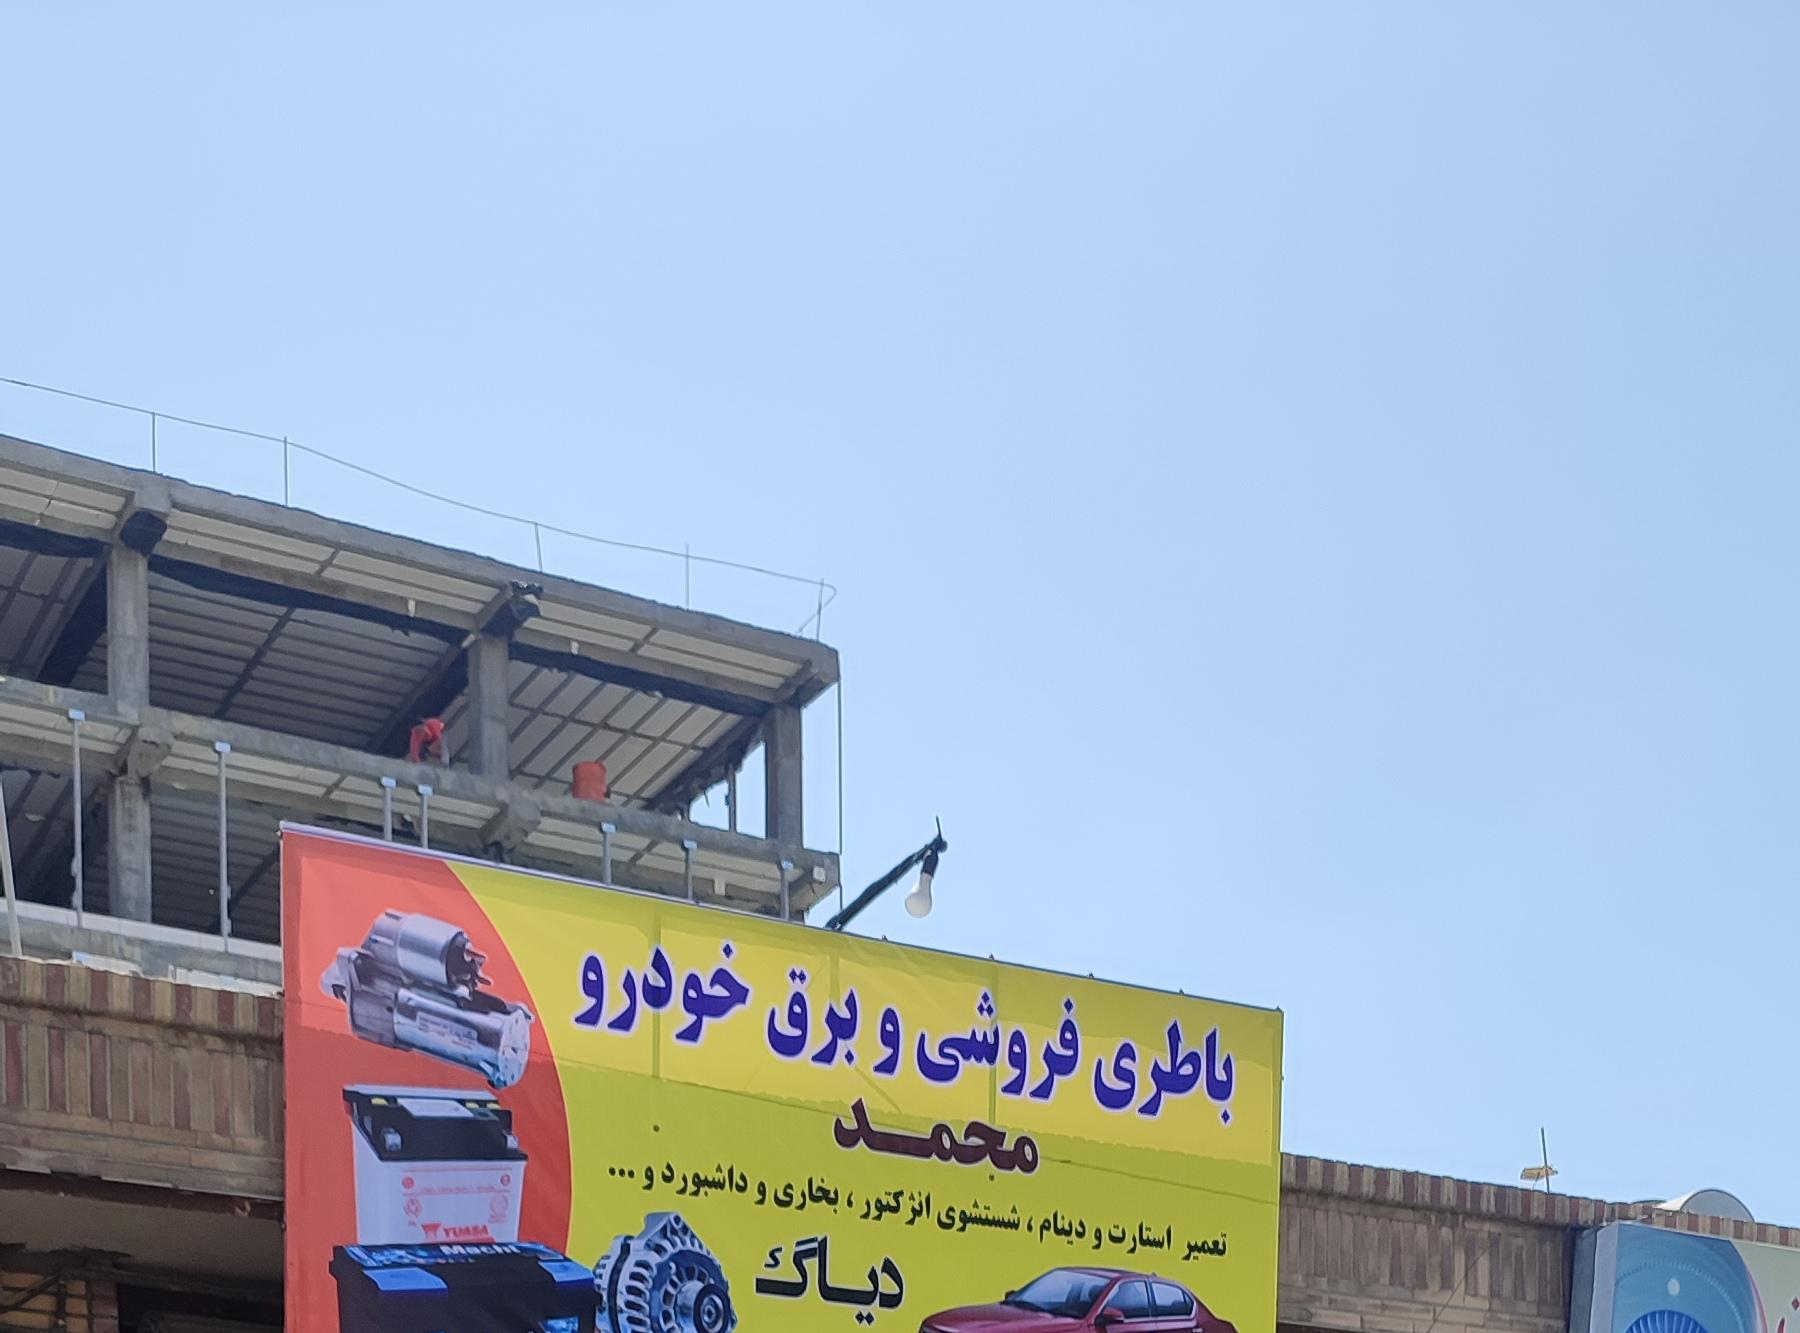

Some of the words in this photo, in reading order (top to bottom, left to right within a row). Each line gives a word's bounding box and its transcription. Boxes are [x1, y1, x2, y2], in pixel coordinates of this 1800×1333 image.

[573, 942, 751, 1044] خودرو
[767, 966, 858, 1066] برق
[872, 1006, 902, 1077] و
[916, 991, 1080, 1101] فروشی
[1094, 1019, 1234, 1125] باطری
[833, 1097, 1040, 1175] محمد
[641, 1165, 655, 1191] و
[660, 1161, 749, 1198] داشبورد
[754, 1180, 767, 1205] و
[773, 1175, 839, 1214] بخاری
[936, 1199, 1021, 1233] شستشوی
[1091, 1225, 1103, 1250] و
[1107, 1221, 1172, 1255] استارت
[1181, 1231, 1228, 1261] تعمیر
[755, 1235, 904, 1326] دیاگ
